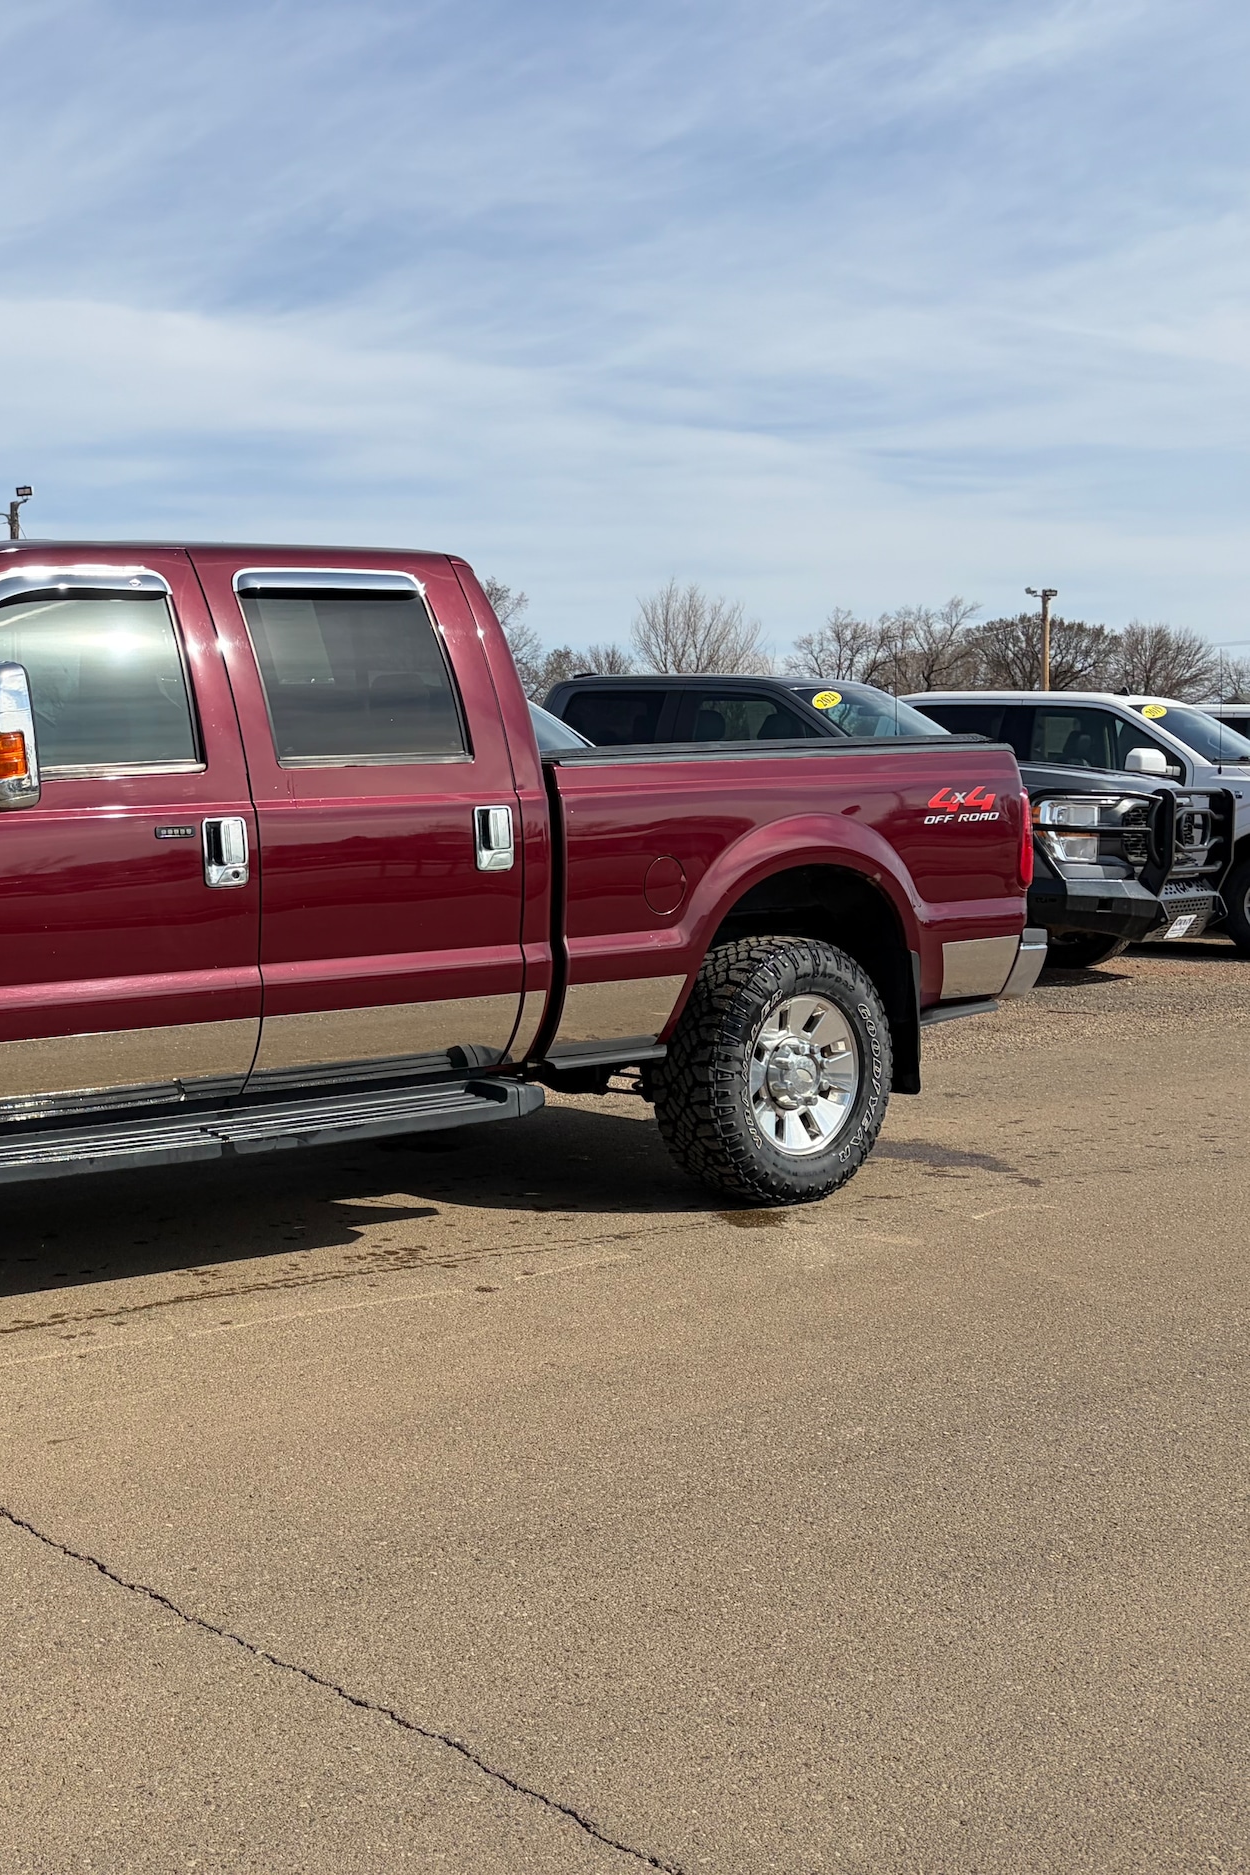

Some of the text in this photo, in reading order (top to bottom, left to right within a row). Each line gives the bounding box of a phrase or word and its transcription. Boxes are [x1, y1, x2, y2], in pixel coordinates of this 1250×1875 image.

[816, 692, 838, 707] 2021
[928, 786, 997, 812] 4x4
[923, 812, 1000, 825] OFF ROAD
[838, 1003, 883, 1163] GOODYEAR
